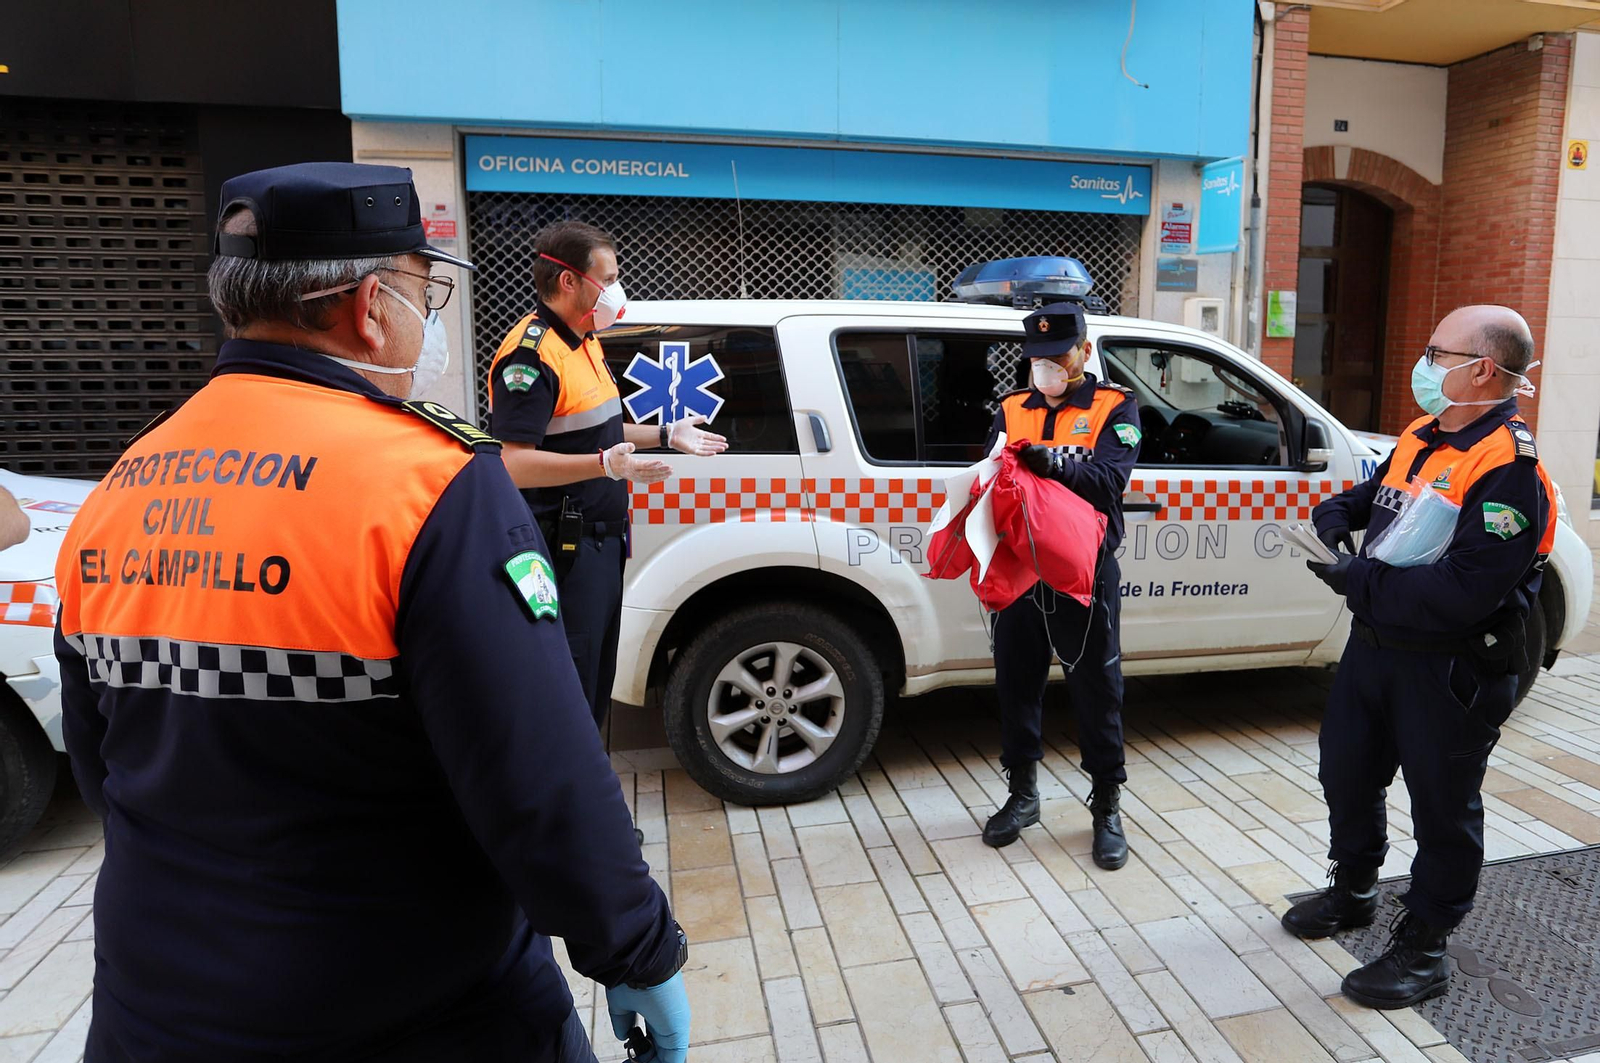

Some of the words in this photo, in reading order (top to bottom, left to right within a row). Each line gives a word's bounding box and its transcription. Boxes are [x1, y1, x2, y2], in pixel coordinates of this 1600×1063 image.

[479, 155, 565, 173] OFICINA
[571, 159, 689, 178] COMERCIAL
[1070, 175, 1120, 191] Sanitas
[1203, 177, 1228, 190] Sanitas
[106, 448, 318, 491] PROTECCION
[143, 498, 216, 536] CIVIL
[80, 549, 111, 584] EL
[121, 548, 291, 595] CAMPILLO
[1120, 582, 1142, 597] de
[1149, 582, 1165, 597] la
[1171, 581, 1249, 597] Frontera
